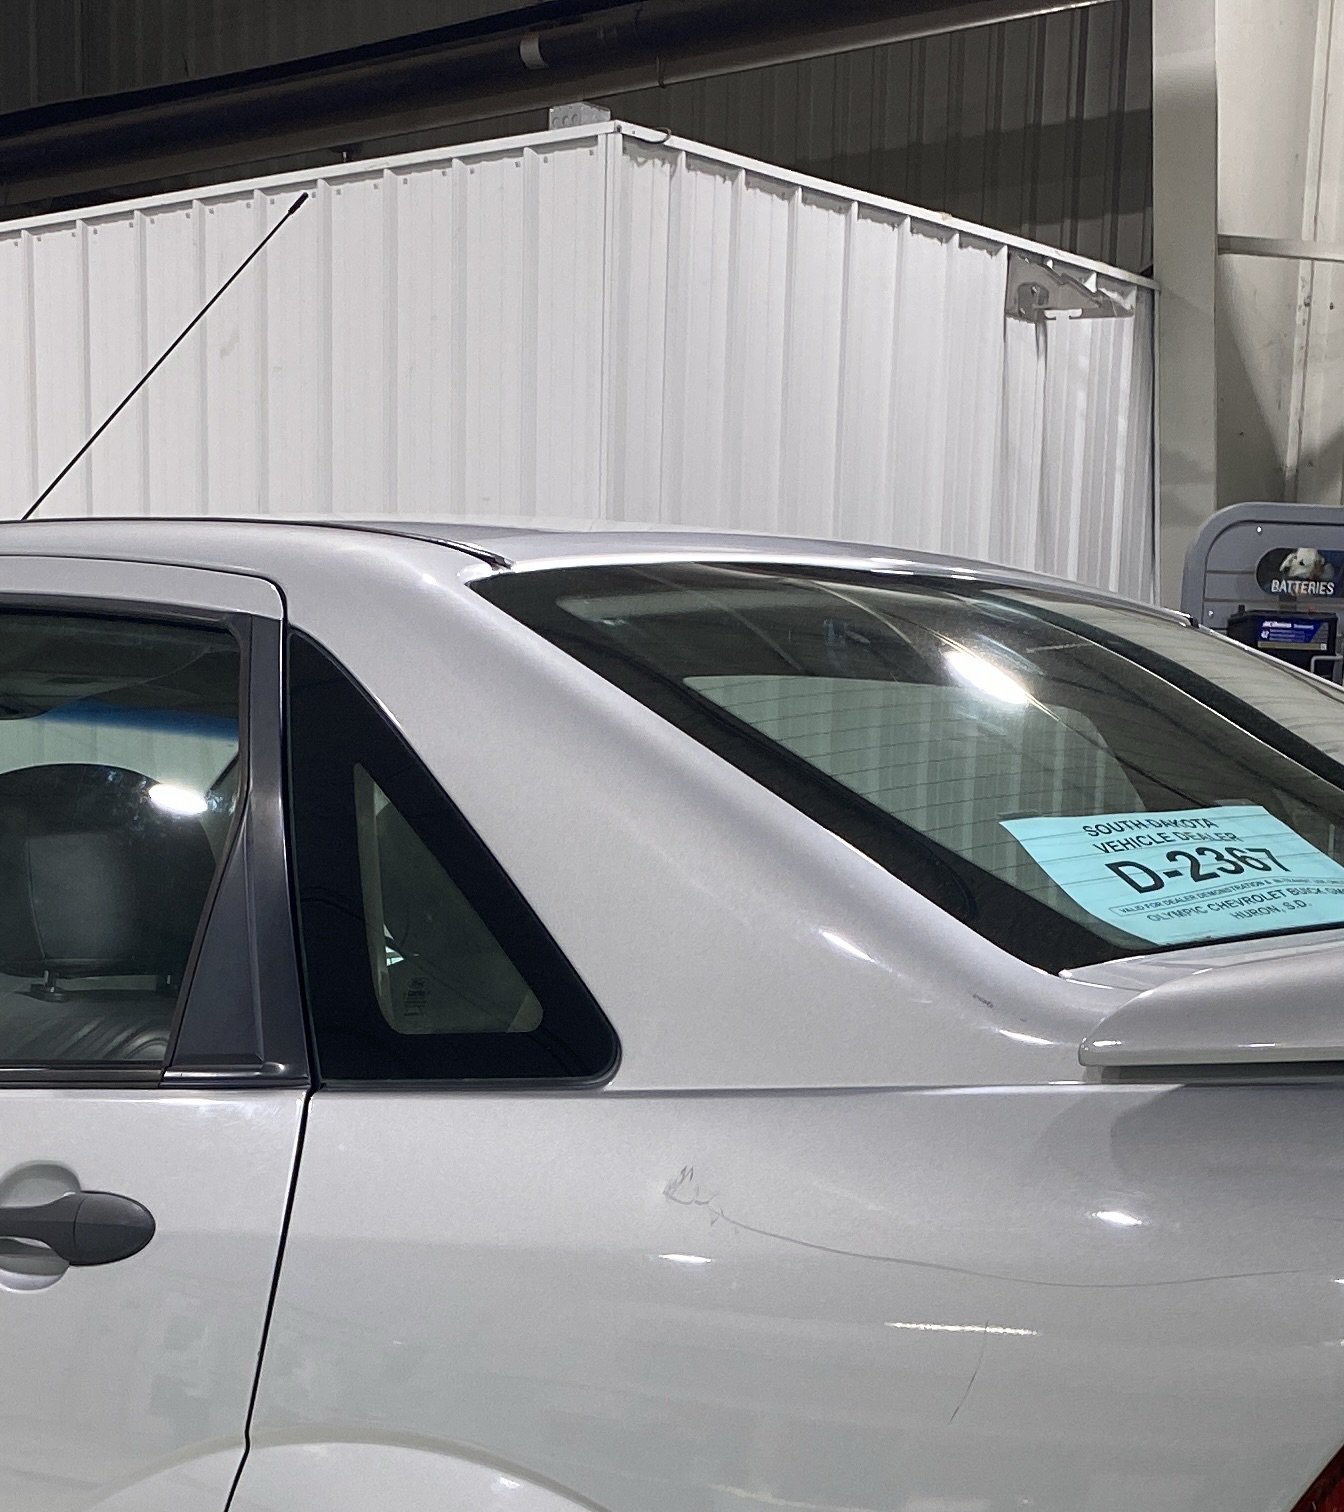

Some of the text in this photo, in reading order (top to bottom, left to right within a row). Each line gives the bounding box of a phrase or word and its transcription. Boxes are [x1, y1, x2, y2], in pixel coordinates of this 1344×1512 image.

[1271, 580, 1335, 595] BATTERIES
[1083, 818, 1220, 837] SOUTH DAKOTA
[1093, 831, 1244, 854] VEHICLE DEALER
[1104, 847, 1292, 894] D-2367
[1120, 904, 1145, 913] VALID
[1163, 895, 1195, 906] DEALER
[1147, 903, 1208, 922] OLYMPIC
[1206, 889, 1287, 912] CHEVROLET
